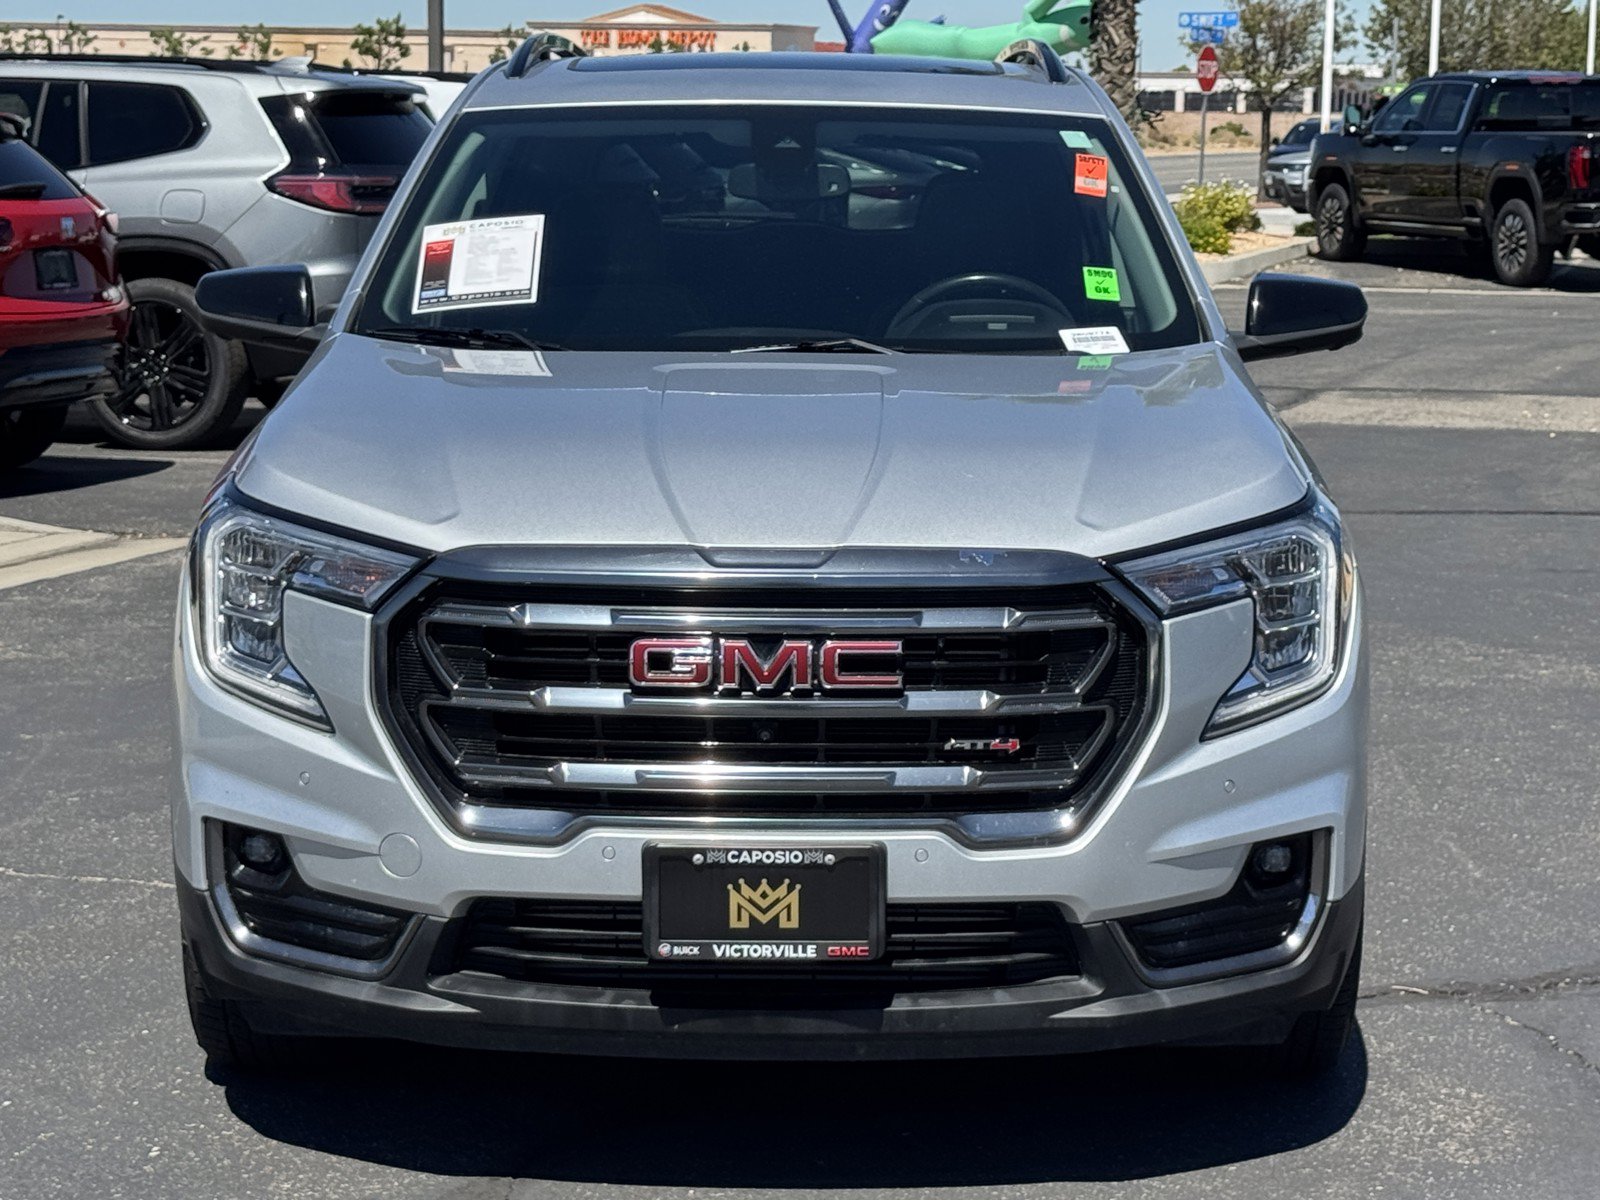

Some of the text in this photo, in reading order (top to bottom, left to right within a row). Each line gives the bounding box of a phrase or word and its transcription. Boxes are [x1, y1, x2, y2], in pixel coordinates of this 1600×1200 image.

[1198, 60, 1219, 79] STOP
[469, 219, 524, 229] CAPOSIO
[1086, 269, 1114, 279] SMOG
[1094, 286, 1111, 294] OK
[629, 638, 904, 690] GMC
[943, 737, 1021, 754] AT4
[726, 850, 803, 865] CAPOSIO
[672, 944, 870, 959] BUICK VICTORVILLE GMC
